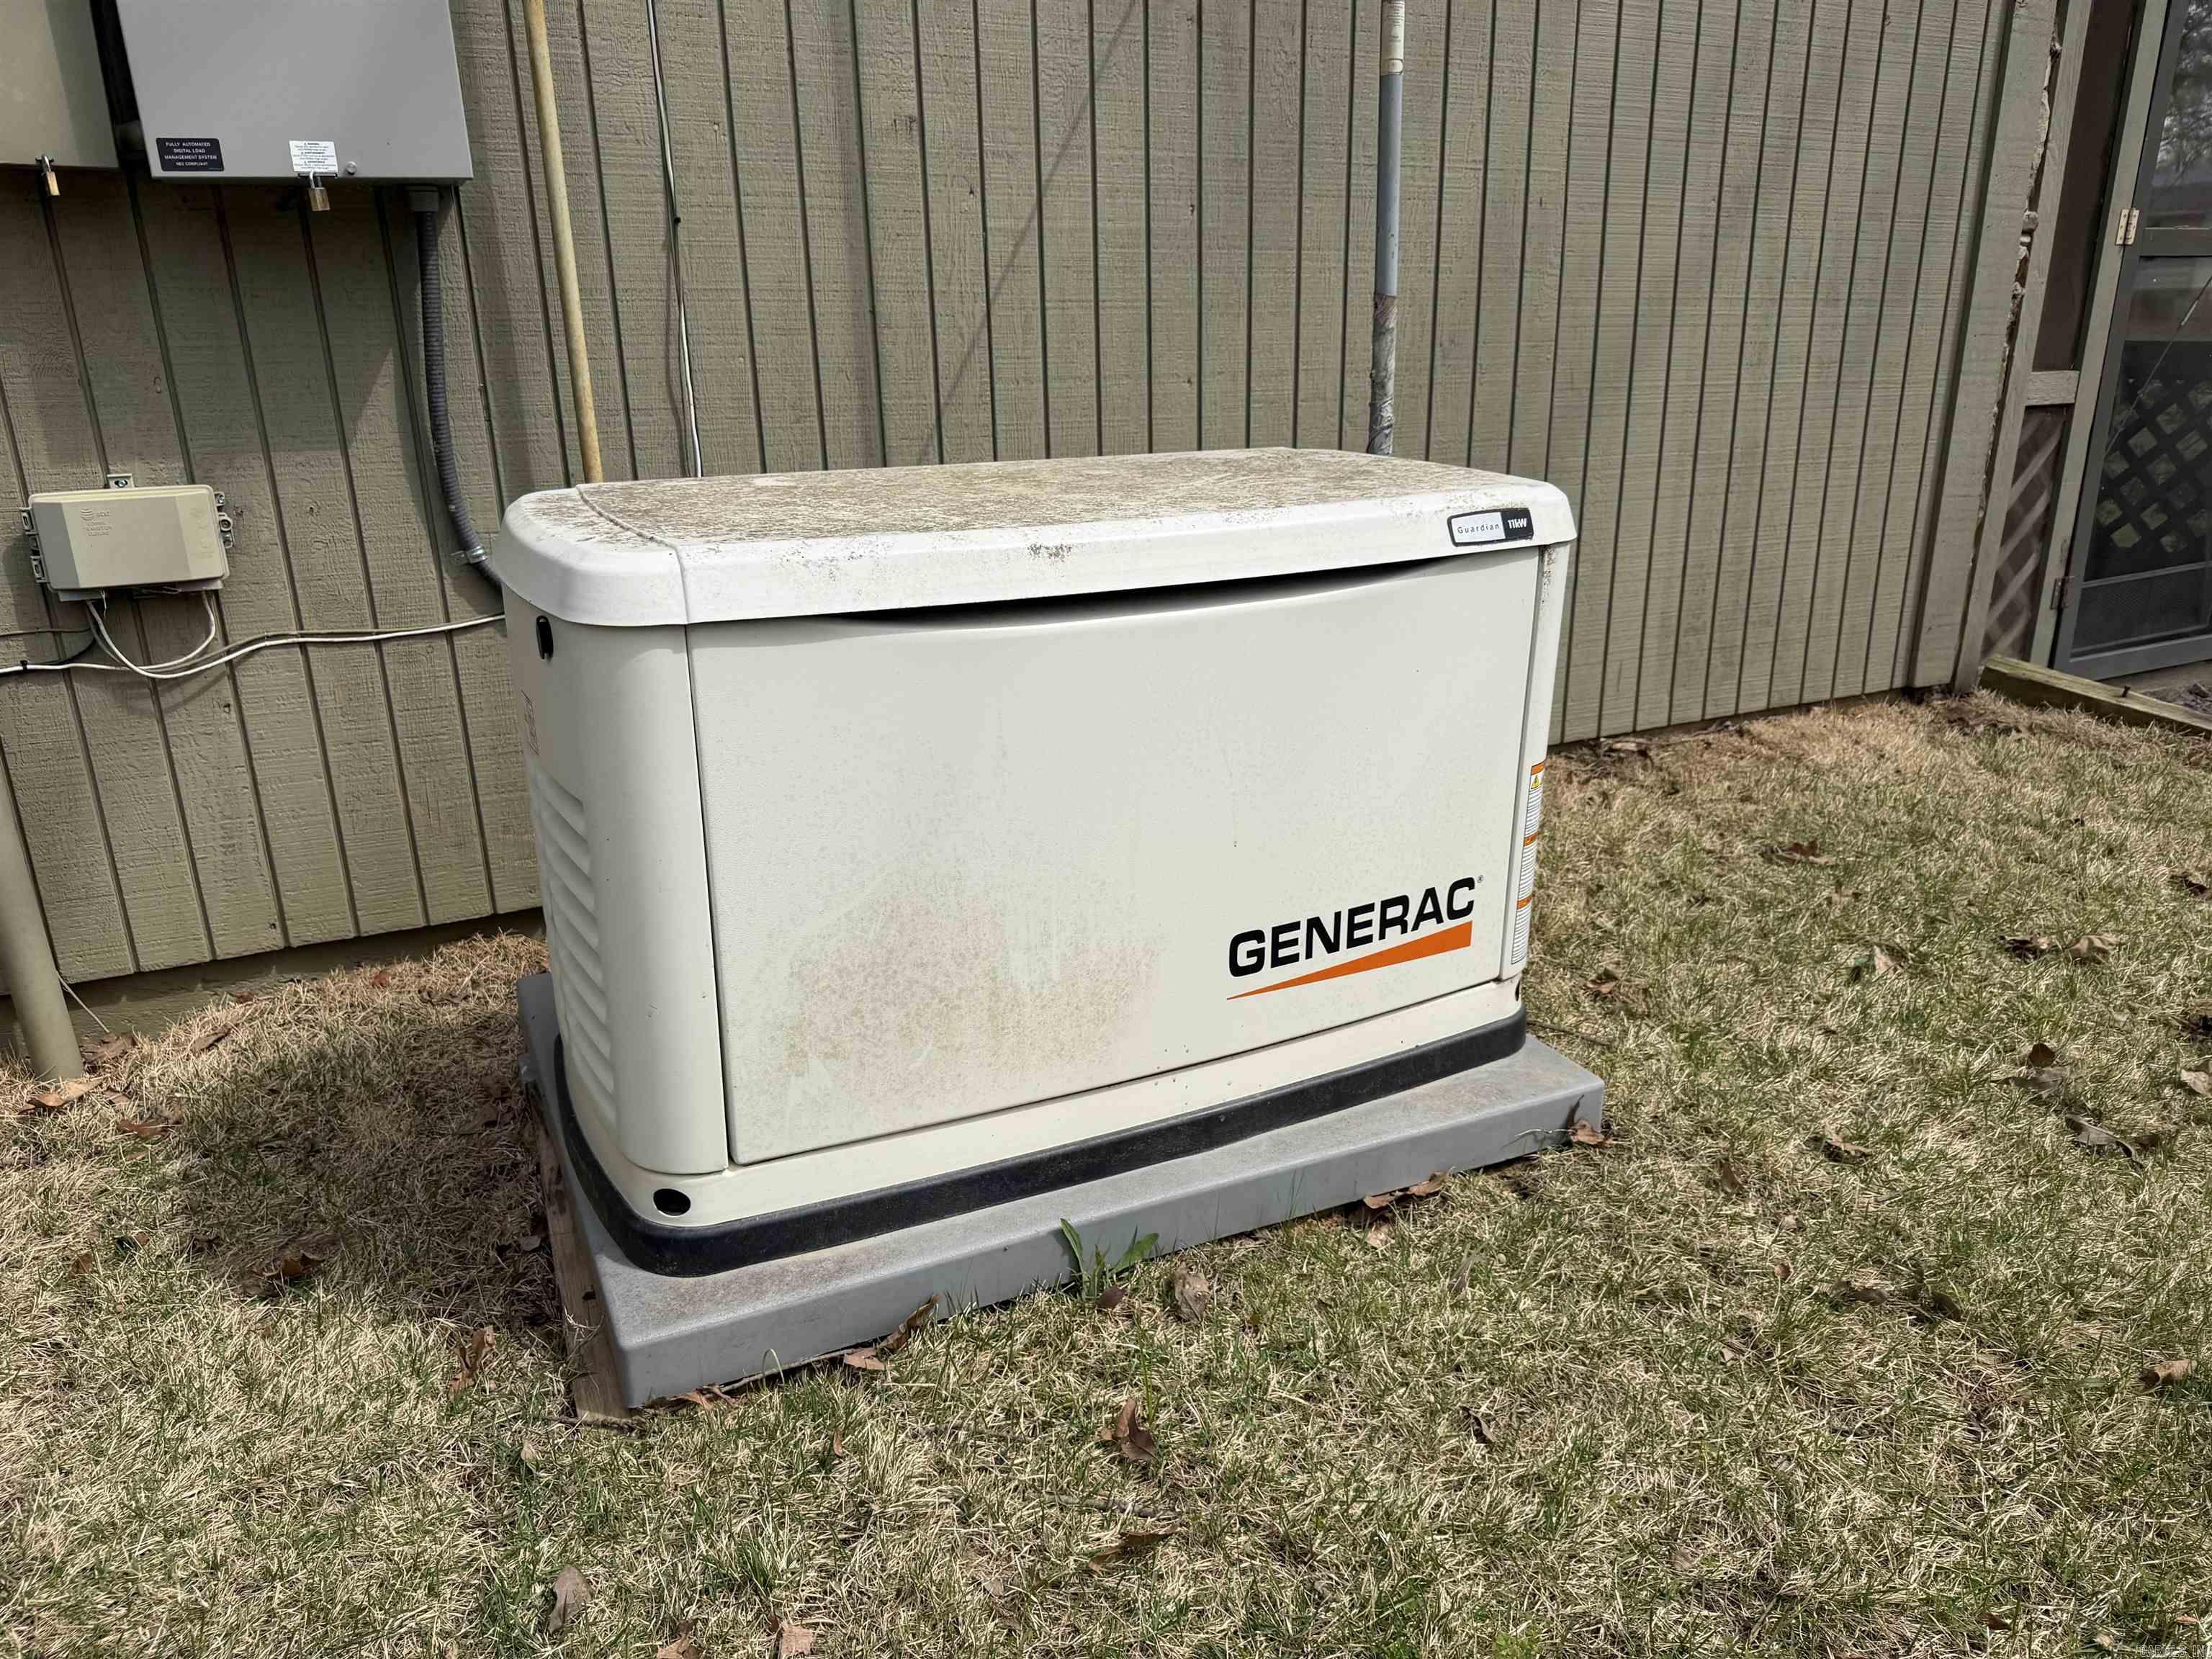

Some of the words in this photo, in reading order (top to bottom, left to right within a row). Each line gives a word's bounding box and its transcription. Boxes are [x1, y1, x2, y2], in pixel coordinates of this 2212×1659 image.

[1457, 523, 1500, 534] Guardian
[1507, 518, 1527, 529] 11kW
[1228, 876, 1475, 978] GENERAC
